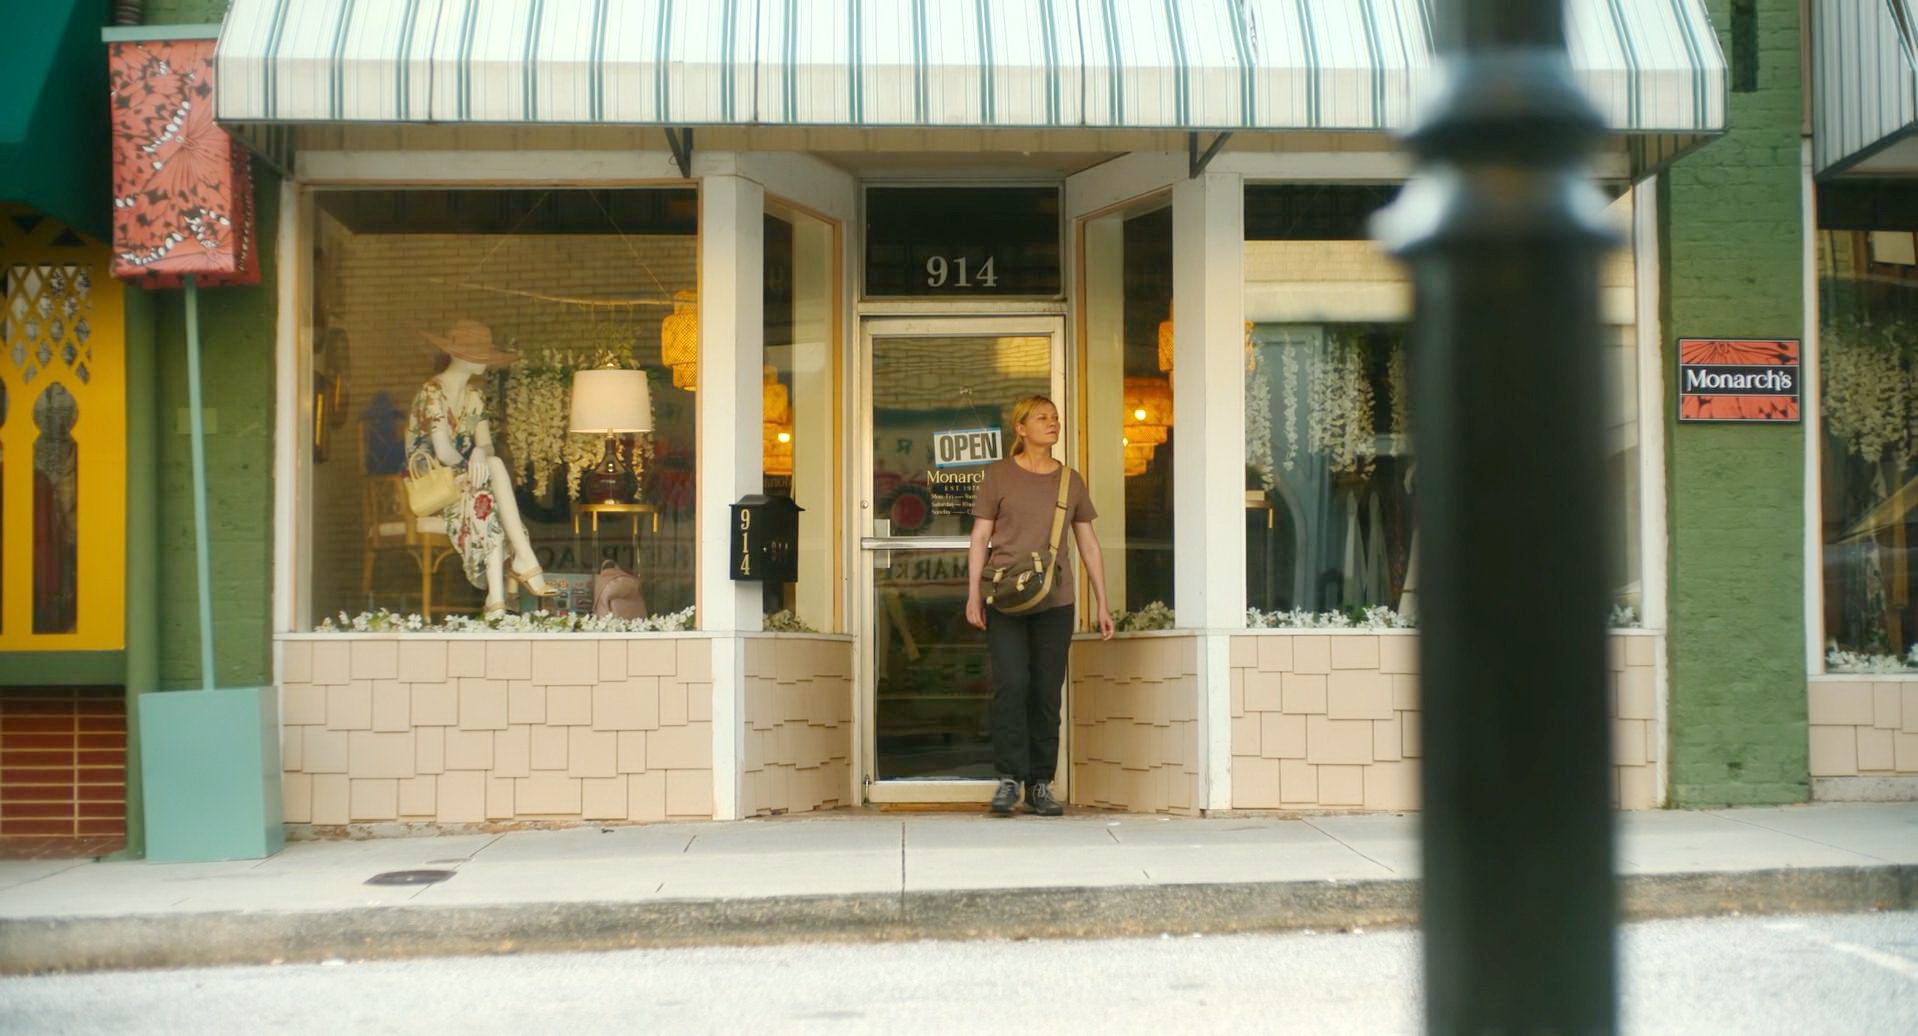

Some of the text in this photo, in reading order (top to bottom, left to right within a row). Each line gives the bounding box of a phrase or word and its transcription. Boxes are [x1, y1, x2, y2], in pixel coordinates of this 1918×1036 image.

[926, 255, 999, 288] 914
[1686, 368, 1792, 392] Monarch's
[939, 431, 998, 462] OPEN
[740, 509, 751, 575] 914
